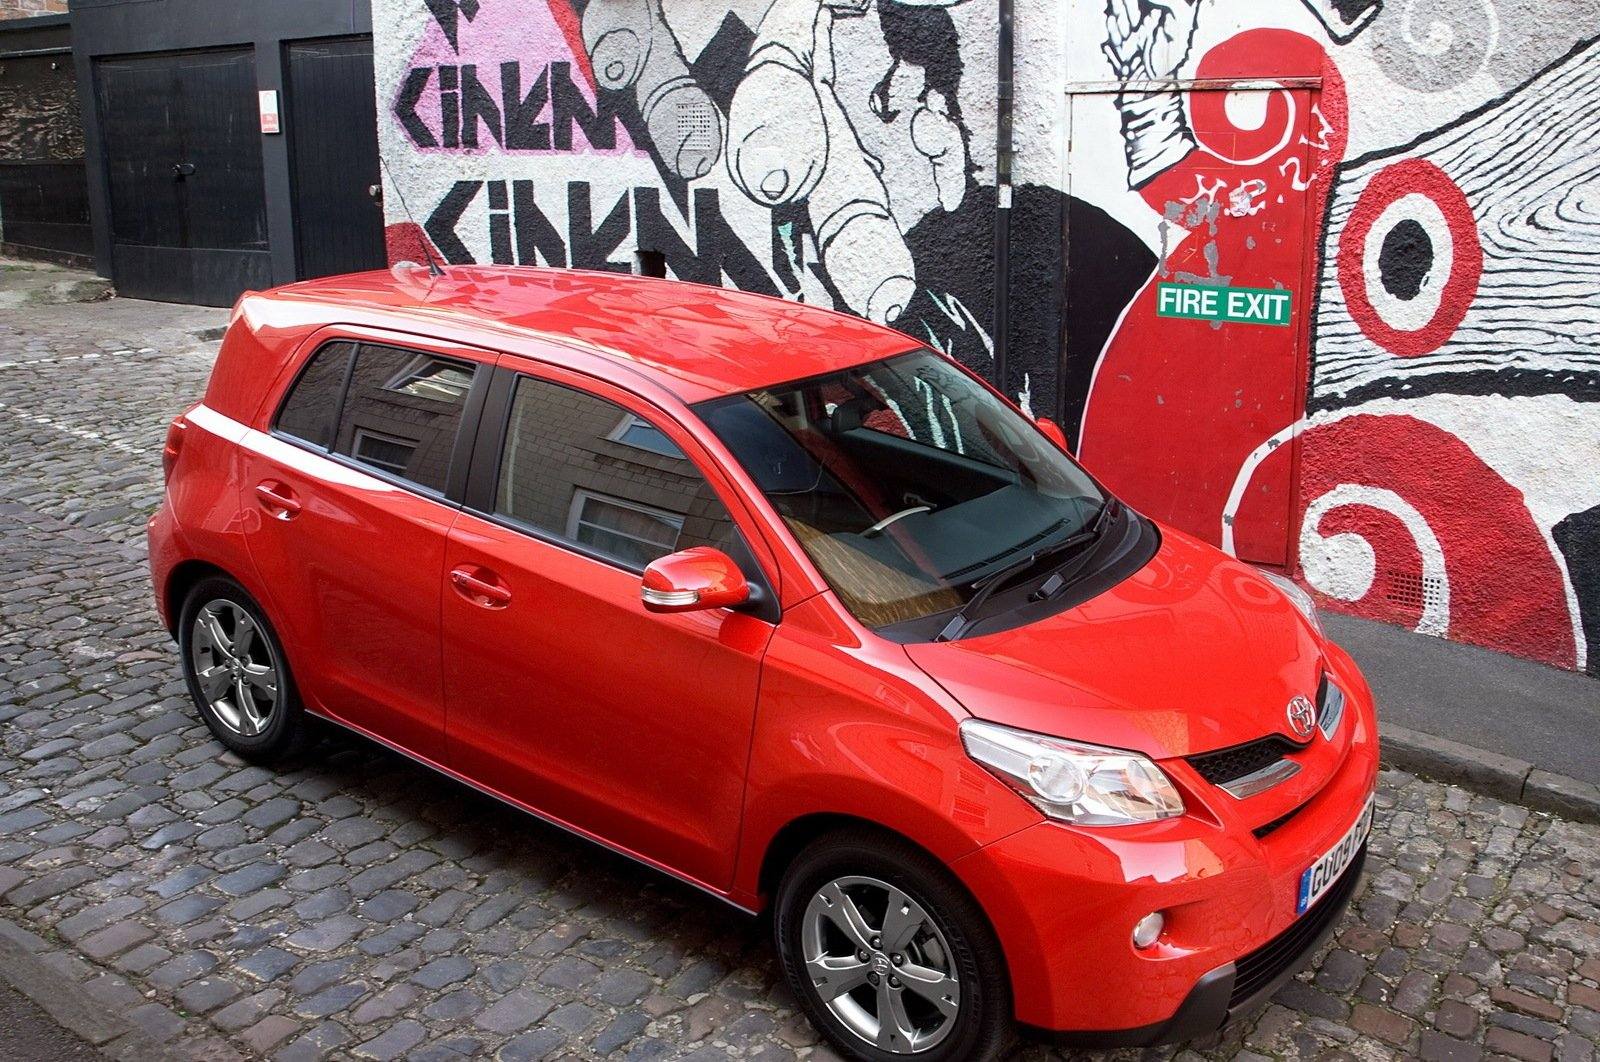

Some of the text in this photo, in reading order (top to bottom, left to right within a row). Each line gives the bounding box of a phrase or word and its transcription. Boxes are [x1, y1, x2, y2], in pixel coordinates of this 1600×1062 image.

[1160, 287, 1289, 321] FIRE EXIT
[1311, 834, 1352, 897] GU09
